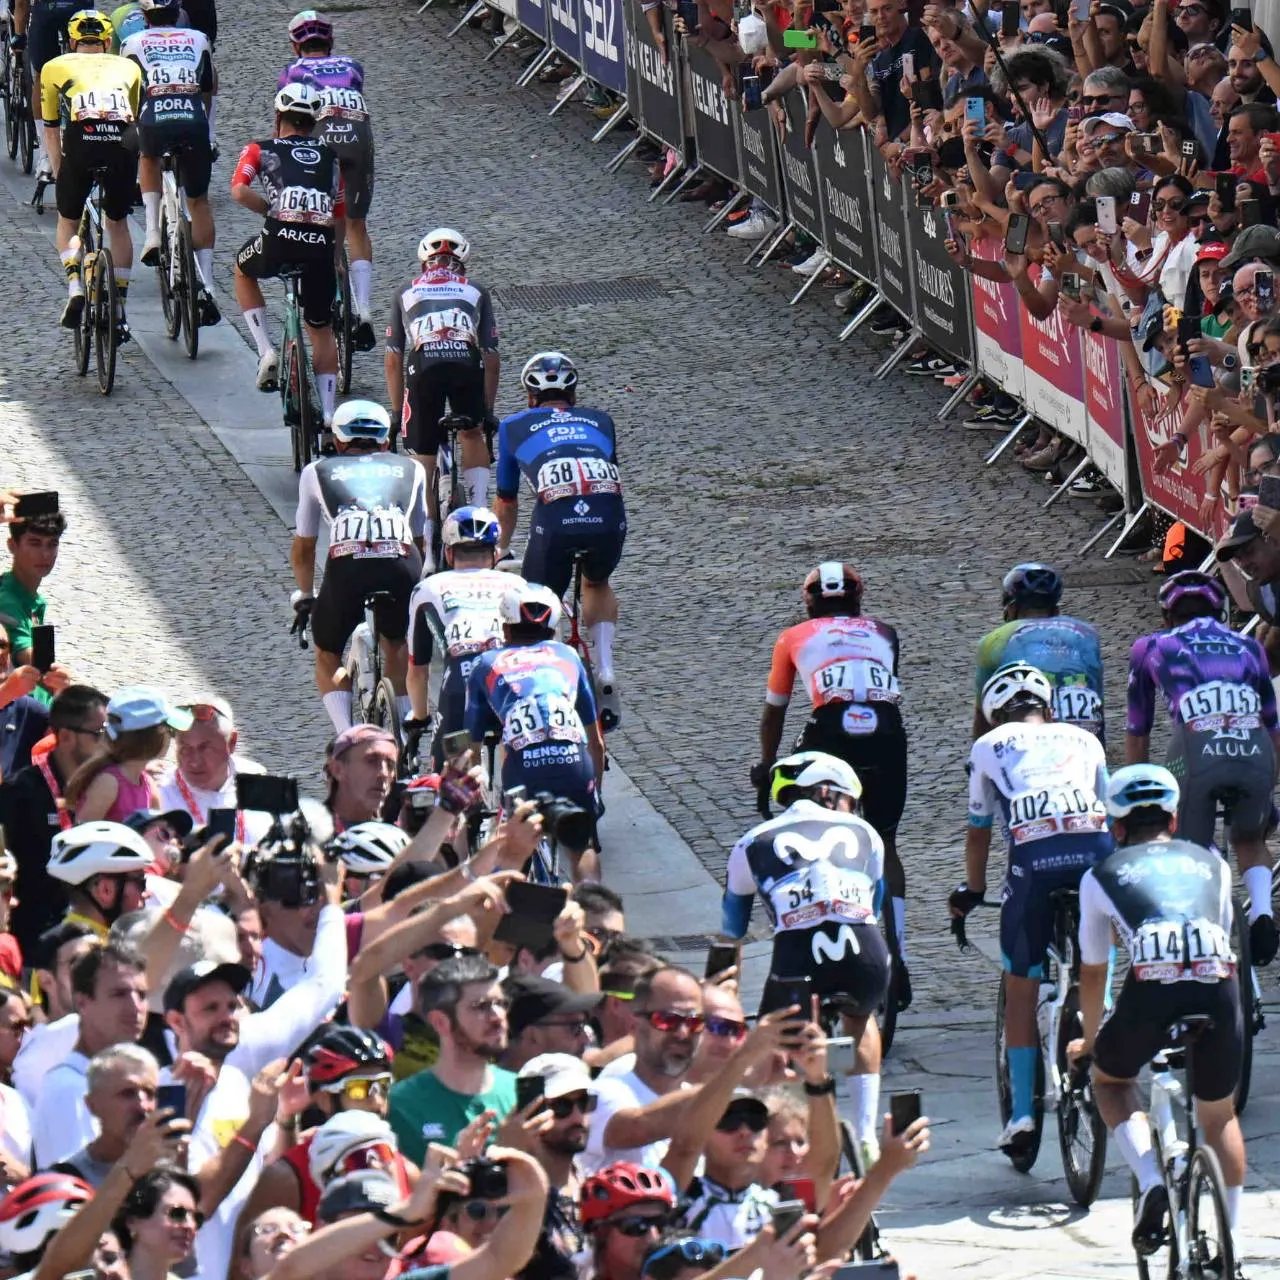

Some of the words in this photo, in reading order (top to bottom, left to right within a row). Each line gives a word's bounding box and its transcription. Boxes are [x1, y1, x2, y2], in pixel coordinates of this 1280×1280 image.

[152, 69, 169, 85] 45
[79, 94, 96, 109] 14
[154, 100, 195, 112] BORA
[96, 124, 121, 133] VISMA
[282, 191, 308, 212] 164
[278, 227, 326, 245] ARKEA
[423, 340, 469, 351] BRUSTOR
[530, 414, 600, 432] Groupama
[547, 426, 576, 437] FDJ
[551, 434, 587, 443] UNITED
[542, 461, 572, 488] 138
[562, 516, 604, 525] DISTRICLOS
[822, 668, 847, 687] 67
[1184, 687, 1220, 718] 157
[510, 705, 536, 731] 53
[522, 744, 579, 760] RENSON
[1202, 742, 1262, 756] ALULA
[523, 754, 580, 768] OUTDOOR
[1011, 792, 1052, 824] 102
[1034, 854, 1084, 868] BAHRAIN
